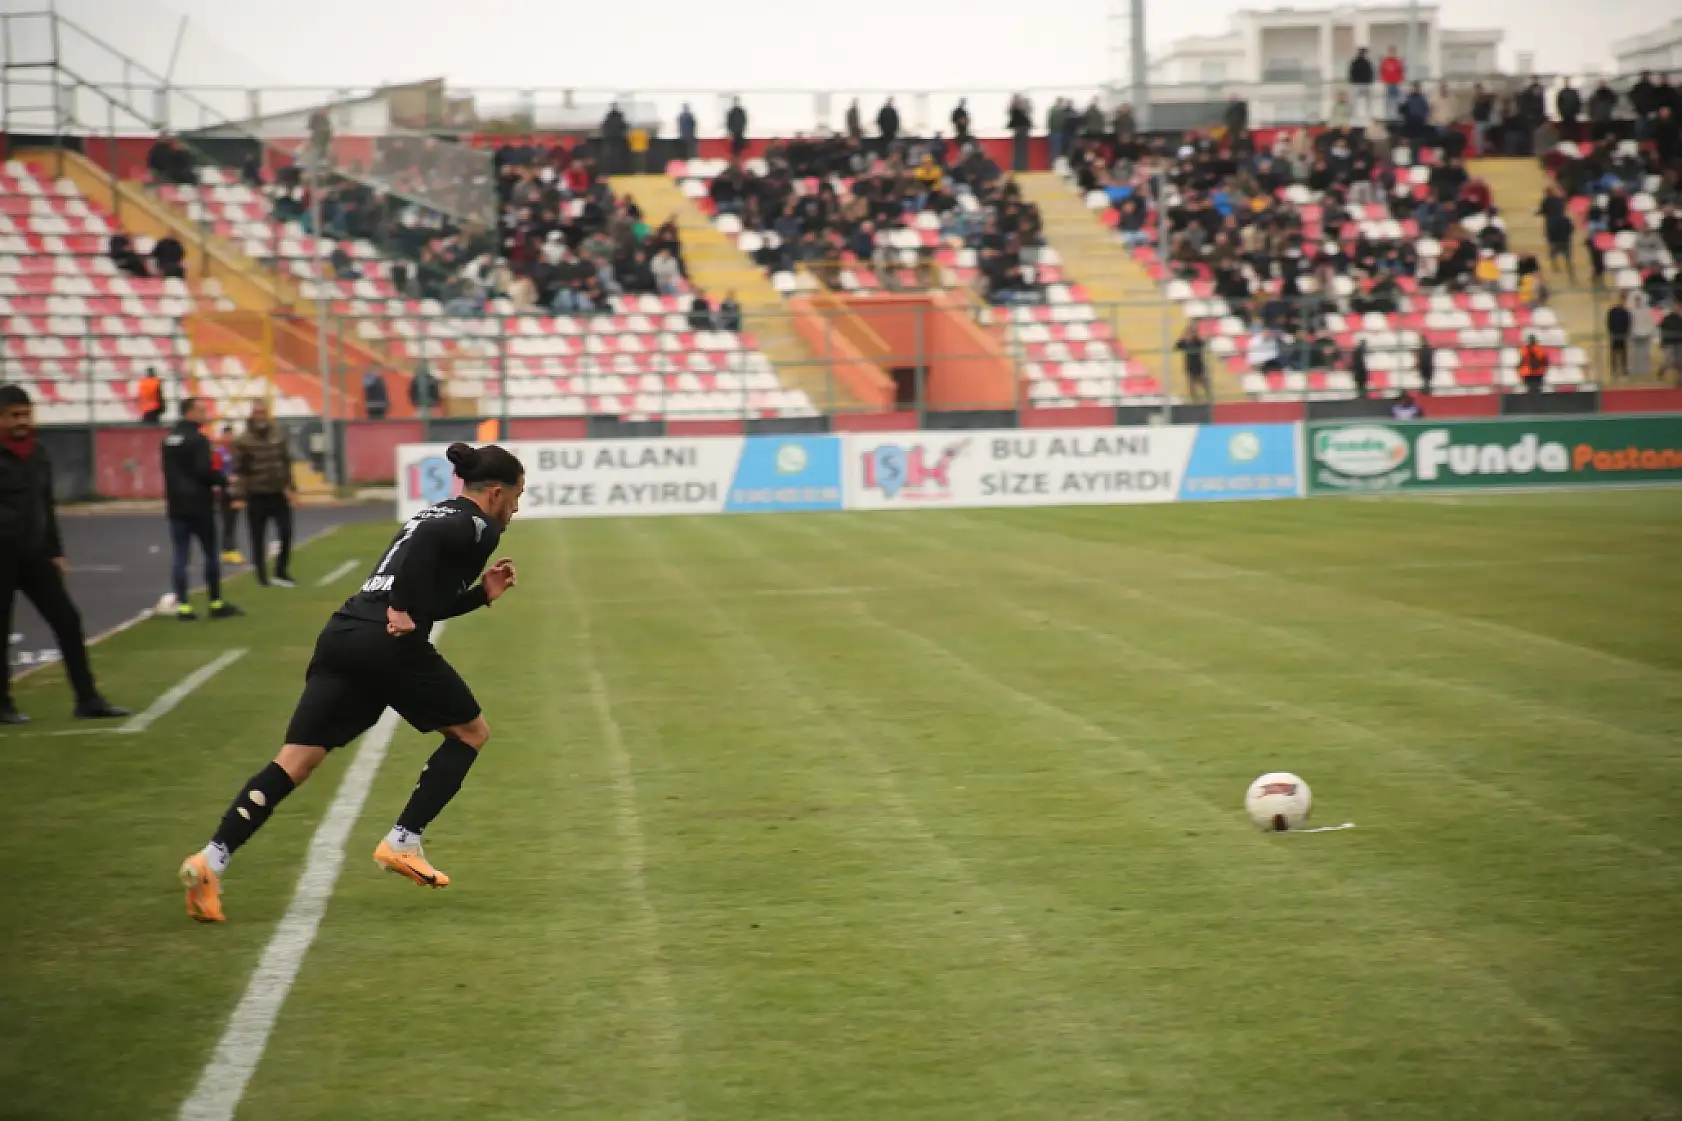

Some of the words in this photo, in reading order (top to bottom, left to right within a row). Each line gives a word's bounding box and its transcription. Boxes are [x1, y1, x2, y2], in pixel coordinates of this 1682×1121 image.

[537, 448, 584, 471] BU
[594, 445, 700, 470] ALANI
[988, 438, 1037, 460] BU
[1047, 434, 1151, 457] ALANI
[1416, 430, 1569, 481] Funda
[528, 482, 597, 507] SİZE
[606, 480, 719, 506] AYIRDI
[979, 470, 1050, 497] SİZE
[1061, 467, 1173, 494] AYIRDI
[377, 519, 426, 574] 7
